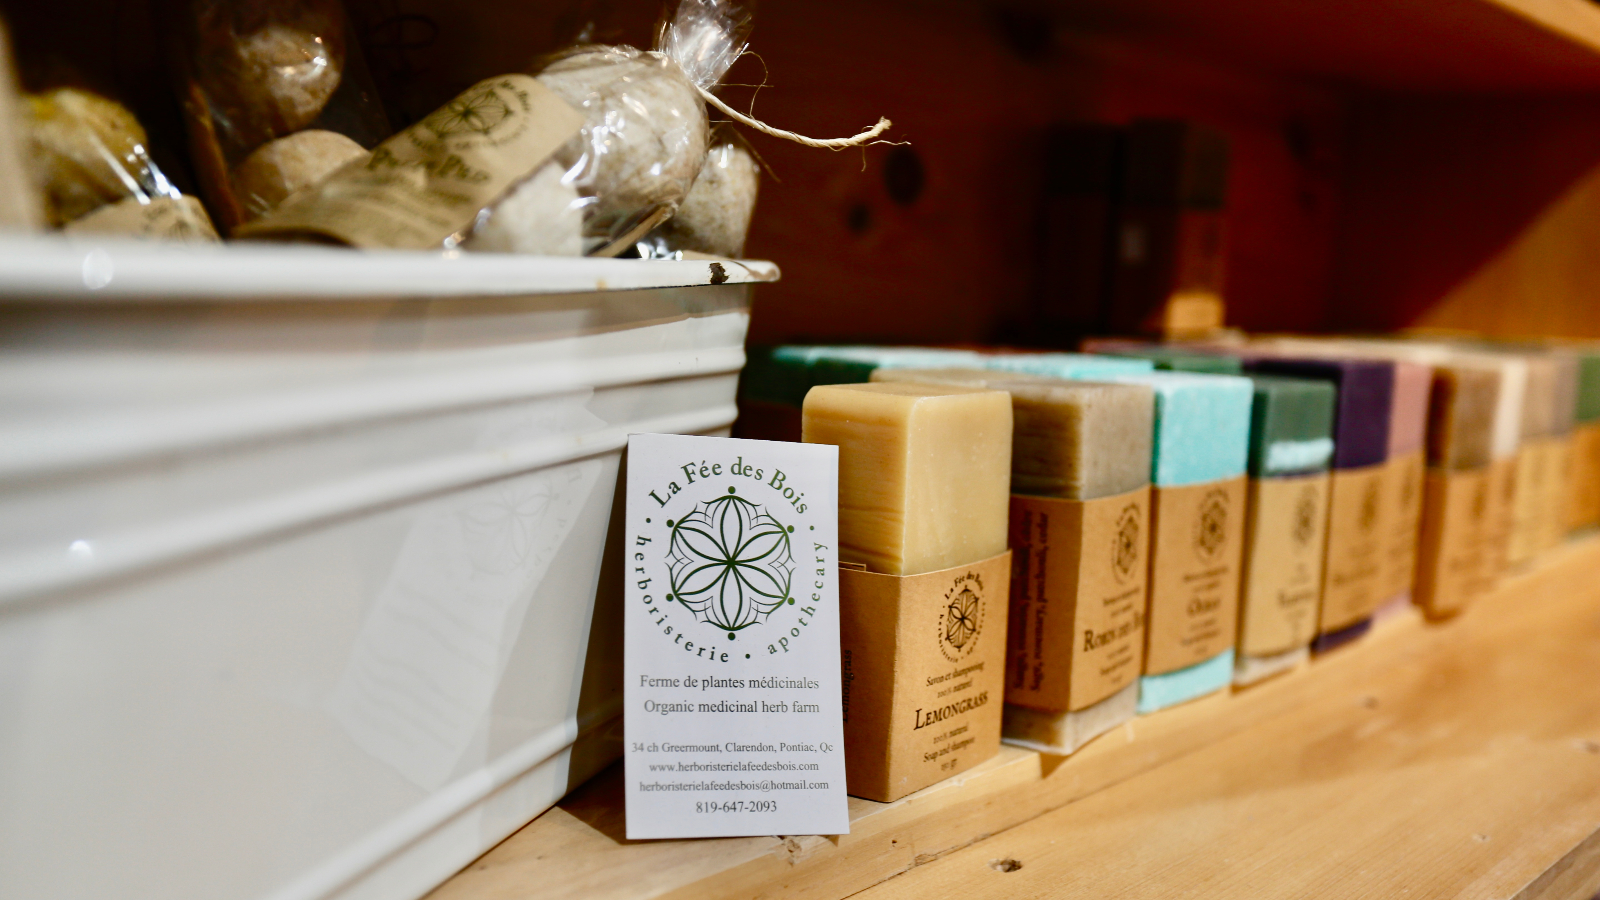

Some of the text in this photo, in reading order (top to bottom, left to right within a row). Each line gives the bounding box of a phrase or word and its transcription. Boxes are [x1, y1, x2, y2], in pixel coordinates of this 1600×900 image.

[648, 456, 808, 514] La Fée des Bois
[634, 535, 729, 662] herboristerie
[768, 542, 829, 655] apothecary
[639, 675, 820, 691] Ferme de plantes médicinales
[644, 699, 820, 715] Organic medicinal herb farm
[631, 742, 834, 755] 34 ch Greermount, Clarendon, Pontiac, Qc
[648, 762, 820, 773] www.herboristerielafeedesbois.com
[639, 779, 830, 793] herboristerielafeedesbois@hotmail.com
[695, 800, 778, 814] 819-647-2093
